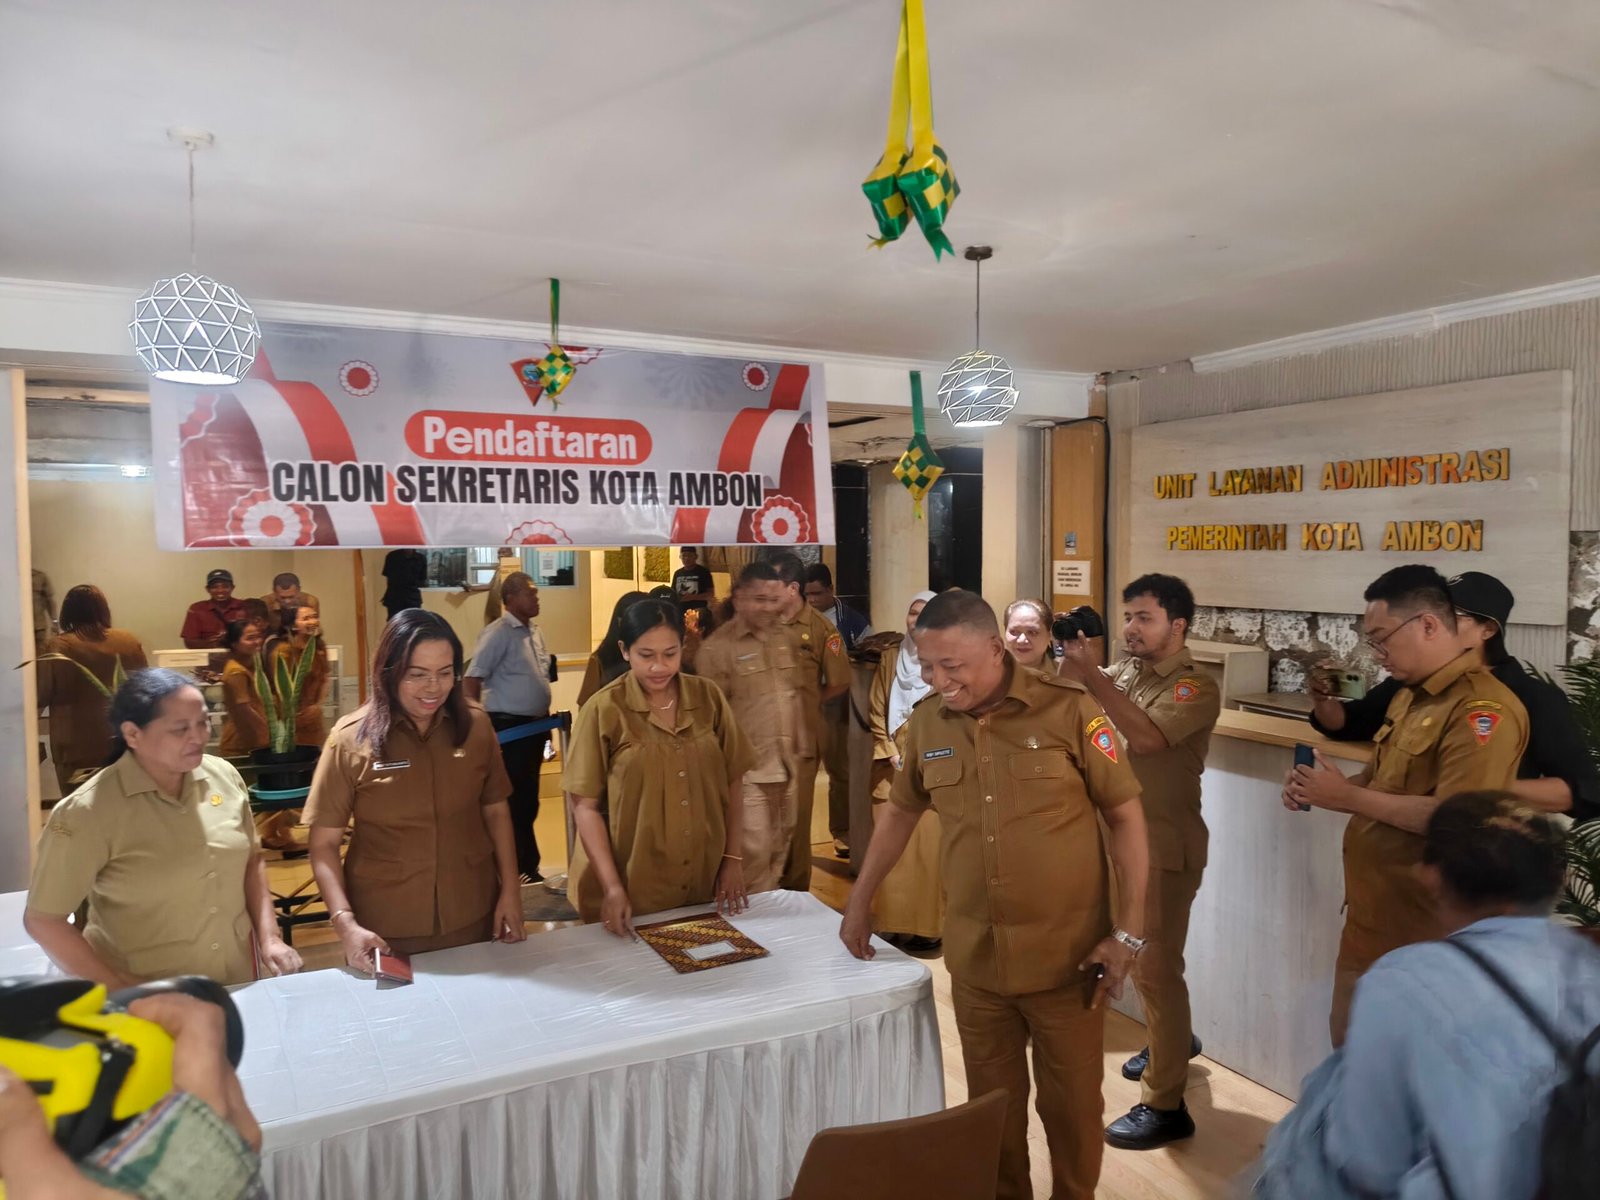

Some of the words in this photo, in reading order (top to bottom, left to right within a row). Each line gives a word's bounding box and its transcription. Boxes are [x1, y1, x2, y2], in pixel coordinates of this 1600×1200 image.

[423, 416, 638, 460] Pendaftaran
[272, 462, 385, 502] CALON
[396, 464, 580, 505] SEKRETARIS
[589, 469, 660, 506] KOTA
[668, 472, 762, 507] AMBON
[1153, 472, 1196, 499] UNIT
[1208, 464, 1304, 497] LAYANAN
[1320, 448, 1510, 491] ADMINISTRASI
[1166, 523, 1287, 551] PEMERINTAH
[1301, 521, 1363, 551] KOTA
[1380, 519, 1484, 552] AMBON
